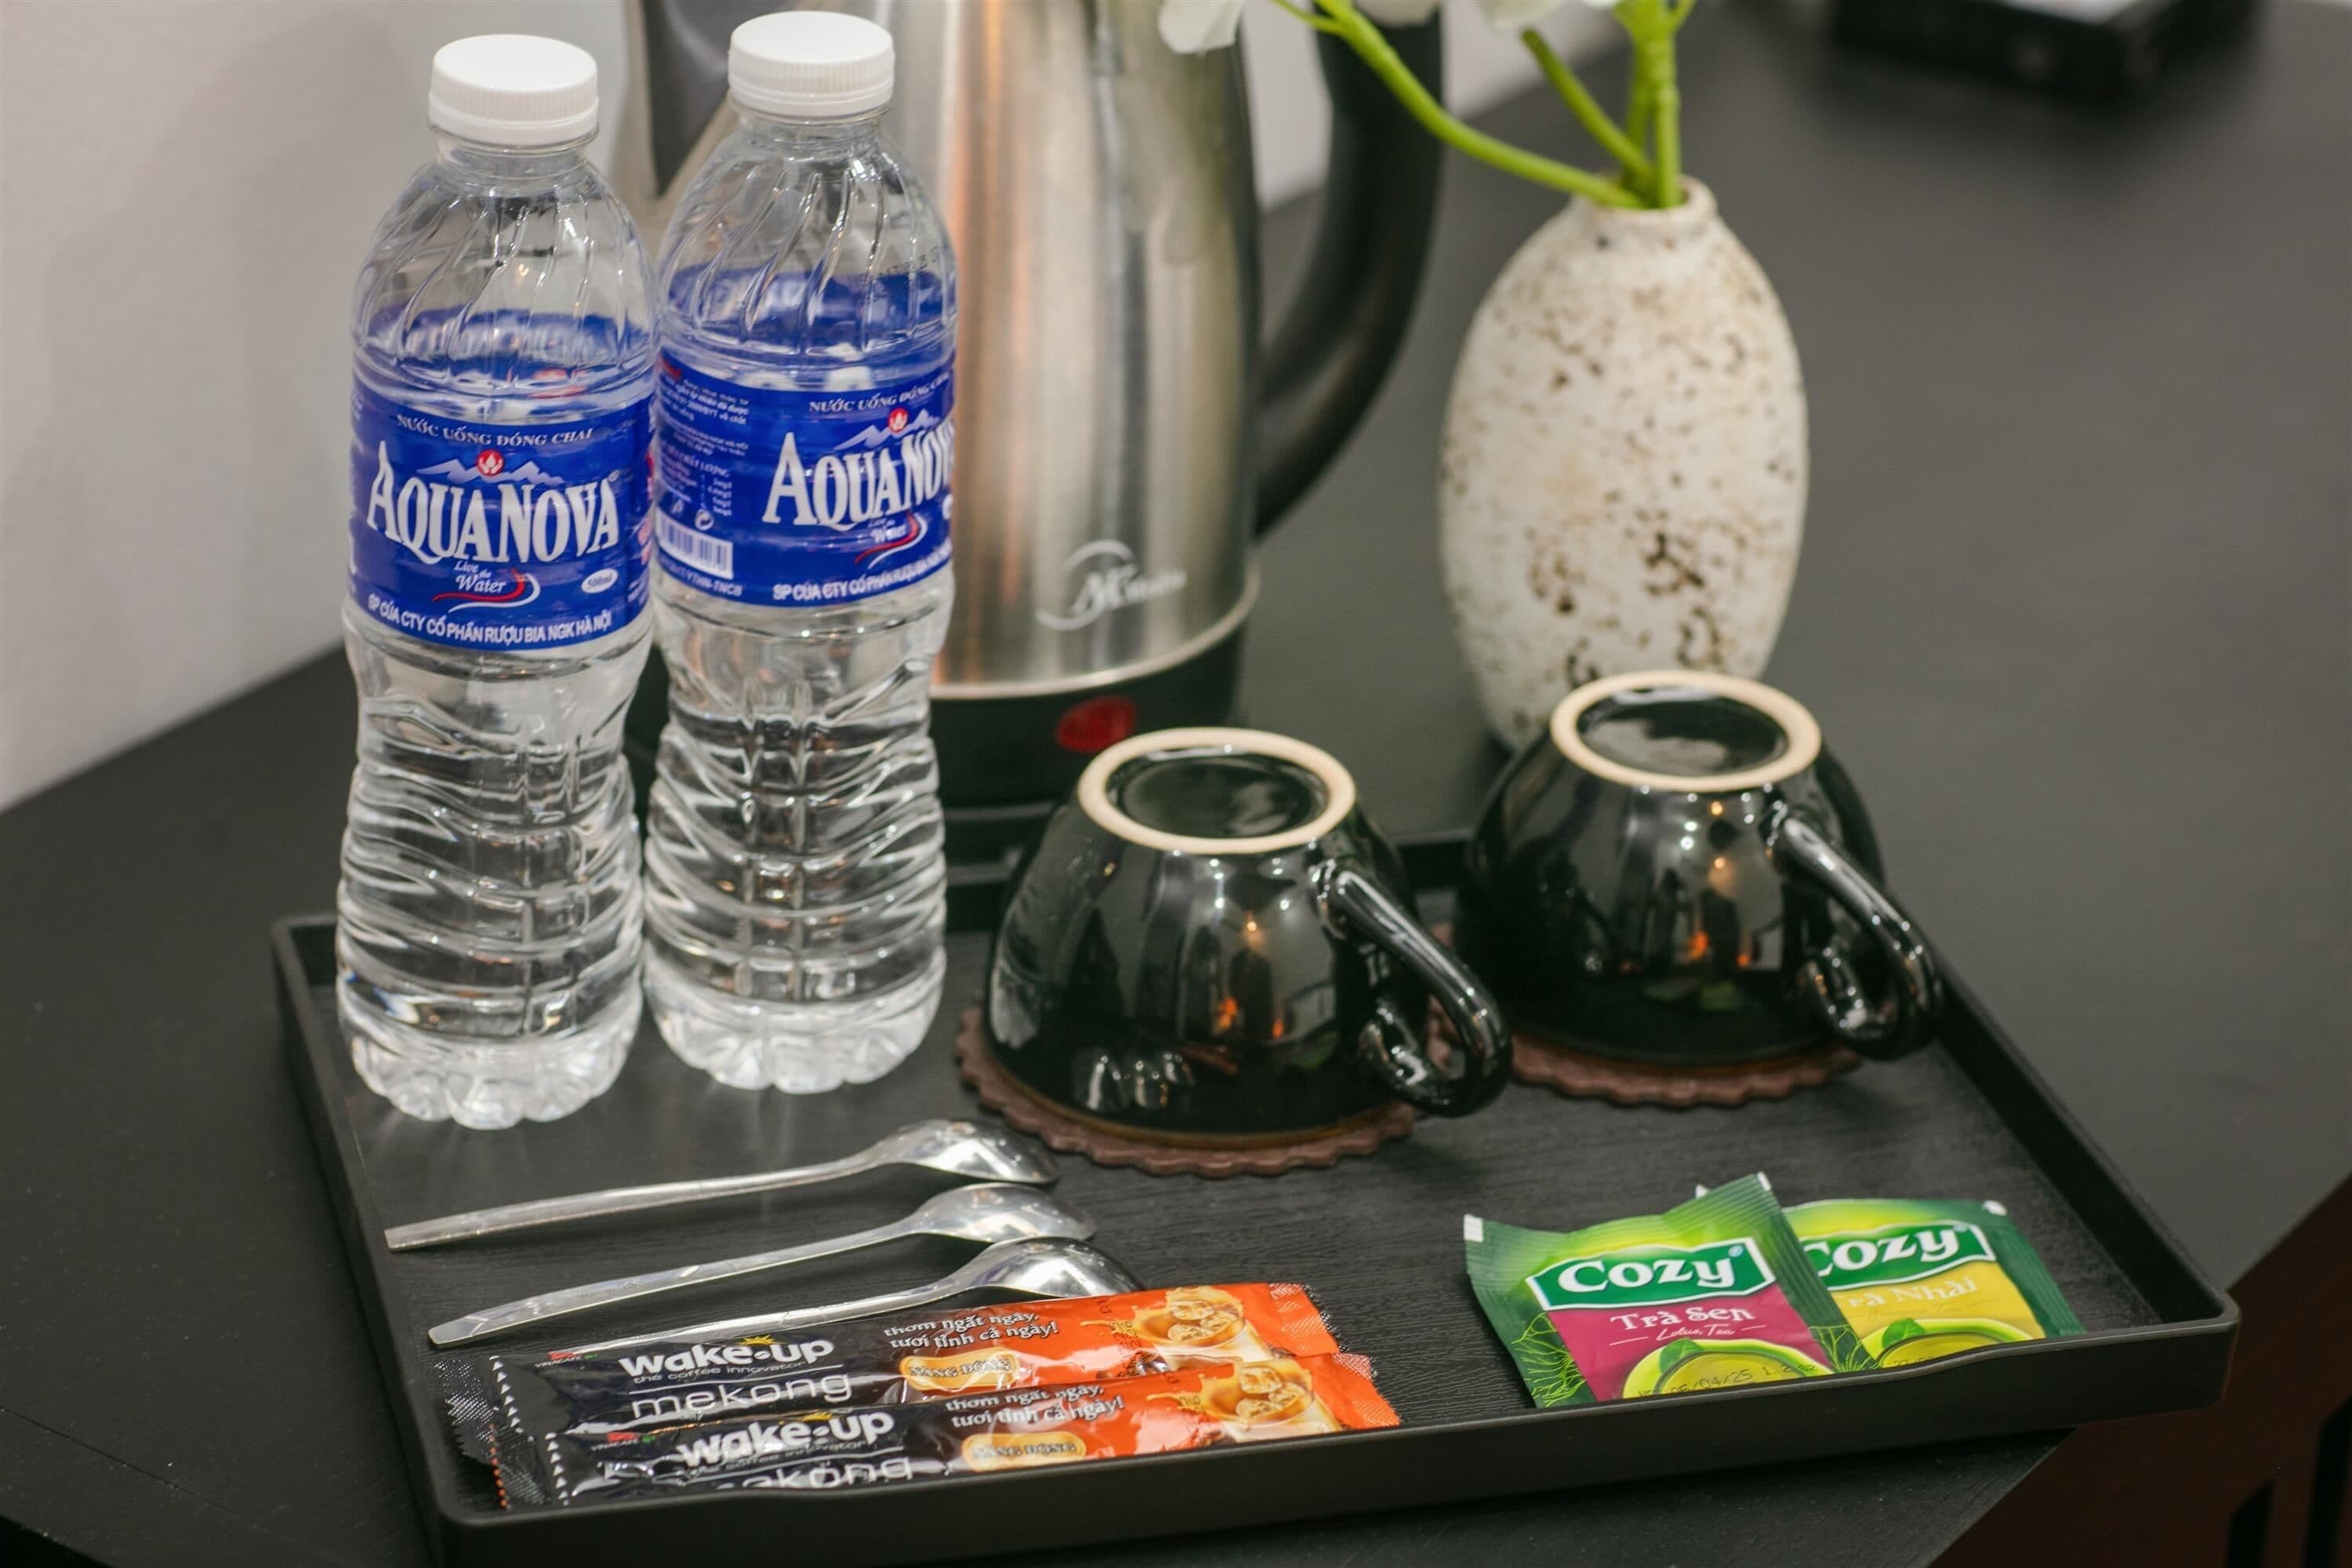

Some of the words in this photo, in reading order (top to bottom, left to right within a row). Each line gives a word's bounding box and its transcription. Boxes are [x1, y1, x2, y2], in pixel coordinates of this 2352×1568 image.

[397, 414, 438, 437] NƯỚC
[443, 426, 492, 445] UỐNG
[496, 432, 548, 446] ĐÓNG
[551, 427, 593, 445] CHAI
[761, 420, 954, 532] AQUANOV
[366, 441, 619, 564] AQUANOVA
[455, 574, 507, 593] Water
[401, 610, 426, 632] CTY
[1558, 1257, 1735, 1293] Cozy
[884, 1319, 937, 1337] thơm
[1610, 1310, 1682, 1330] Trà
[1685, 1306, 1756, 1323] Sen
[889, 1334, 931, 1348] tươi
[1006, 1320, 1059, 1339] ngày!
[667, 1367, 721, 1381] coffee
[726, 1361, 807, 1374] innovator
[631, 1373, 852, 1419] mekong
[945, 1394, 1000, 1412] thơm
[950, 1411, 993, 1428] tươi
